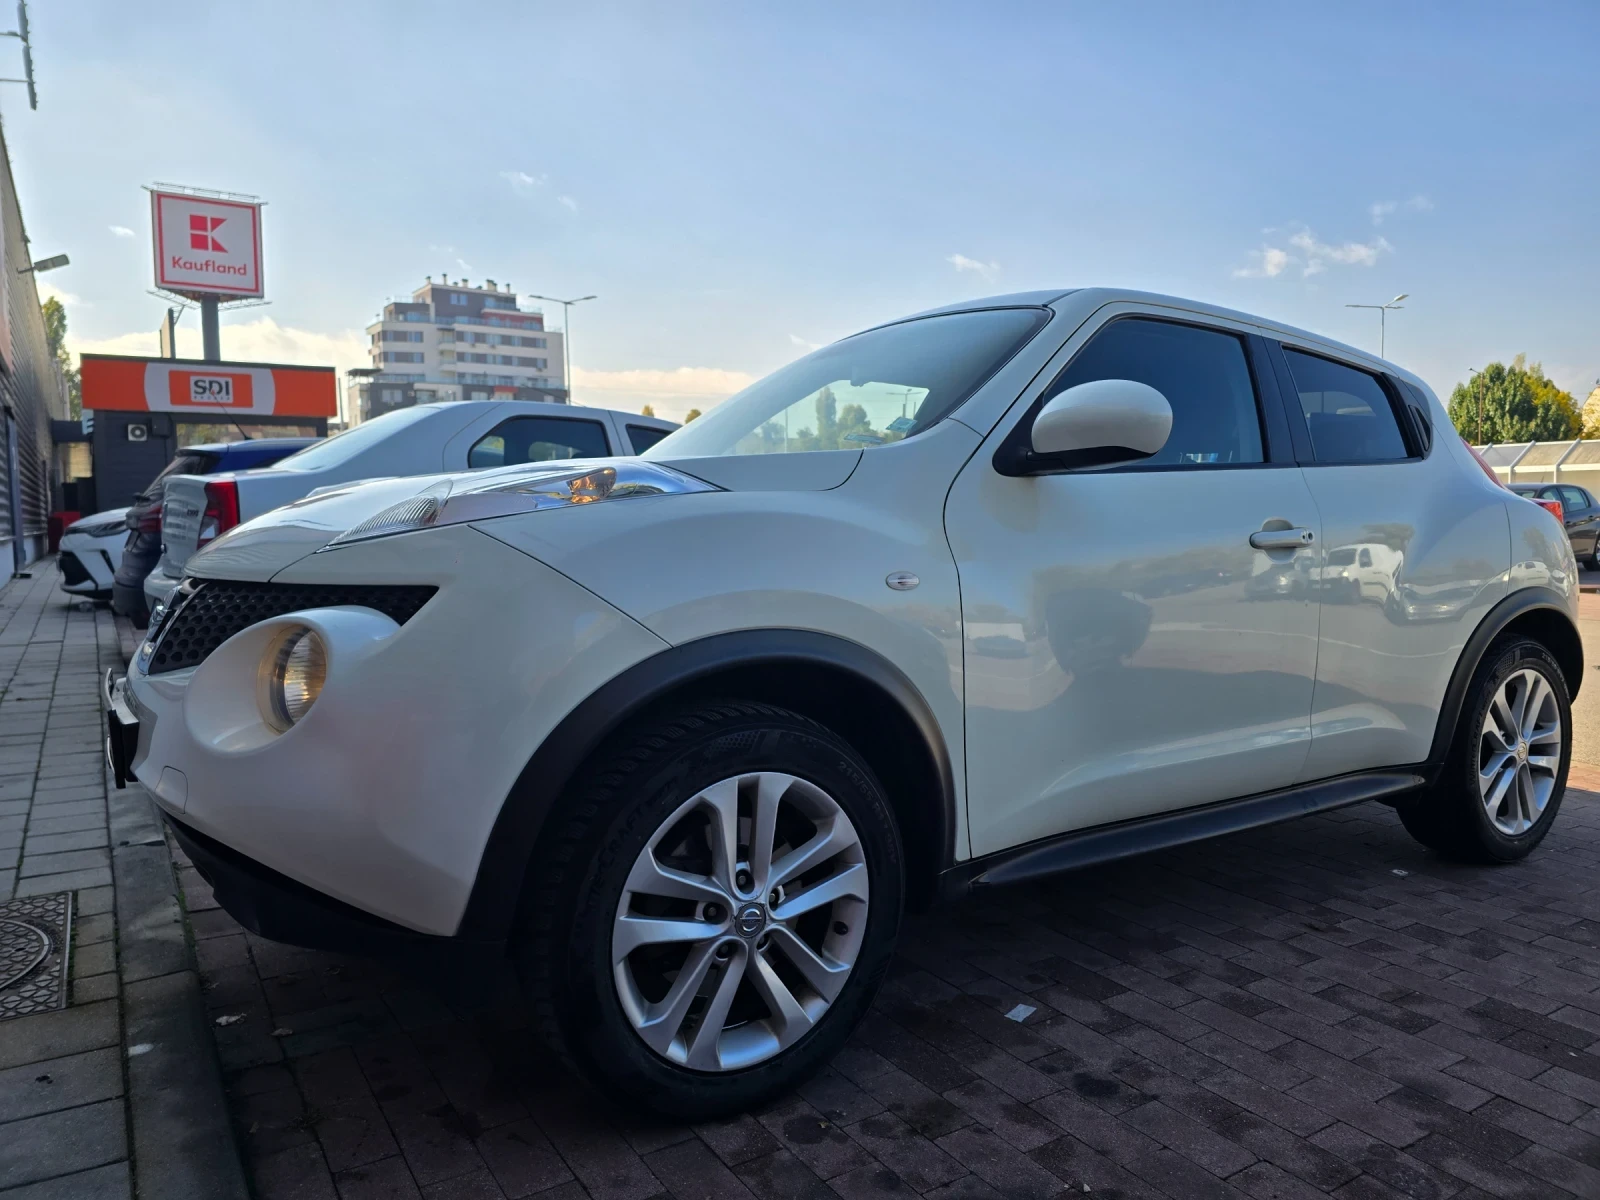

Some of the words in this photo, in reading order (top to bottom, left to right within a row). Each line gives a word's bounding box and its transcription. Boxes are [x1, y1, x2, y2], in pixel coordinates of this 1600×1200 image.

[190, 214, 228, 253] K
[173, 257, 247, 276] Kaufland
[194, 379, 230, 396] SDI
